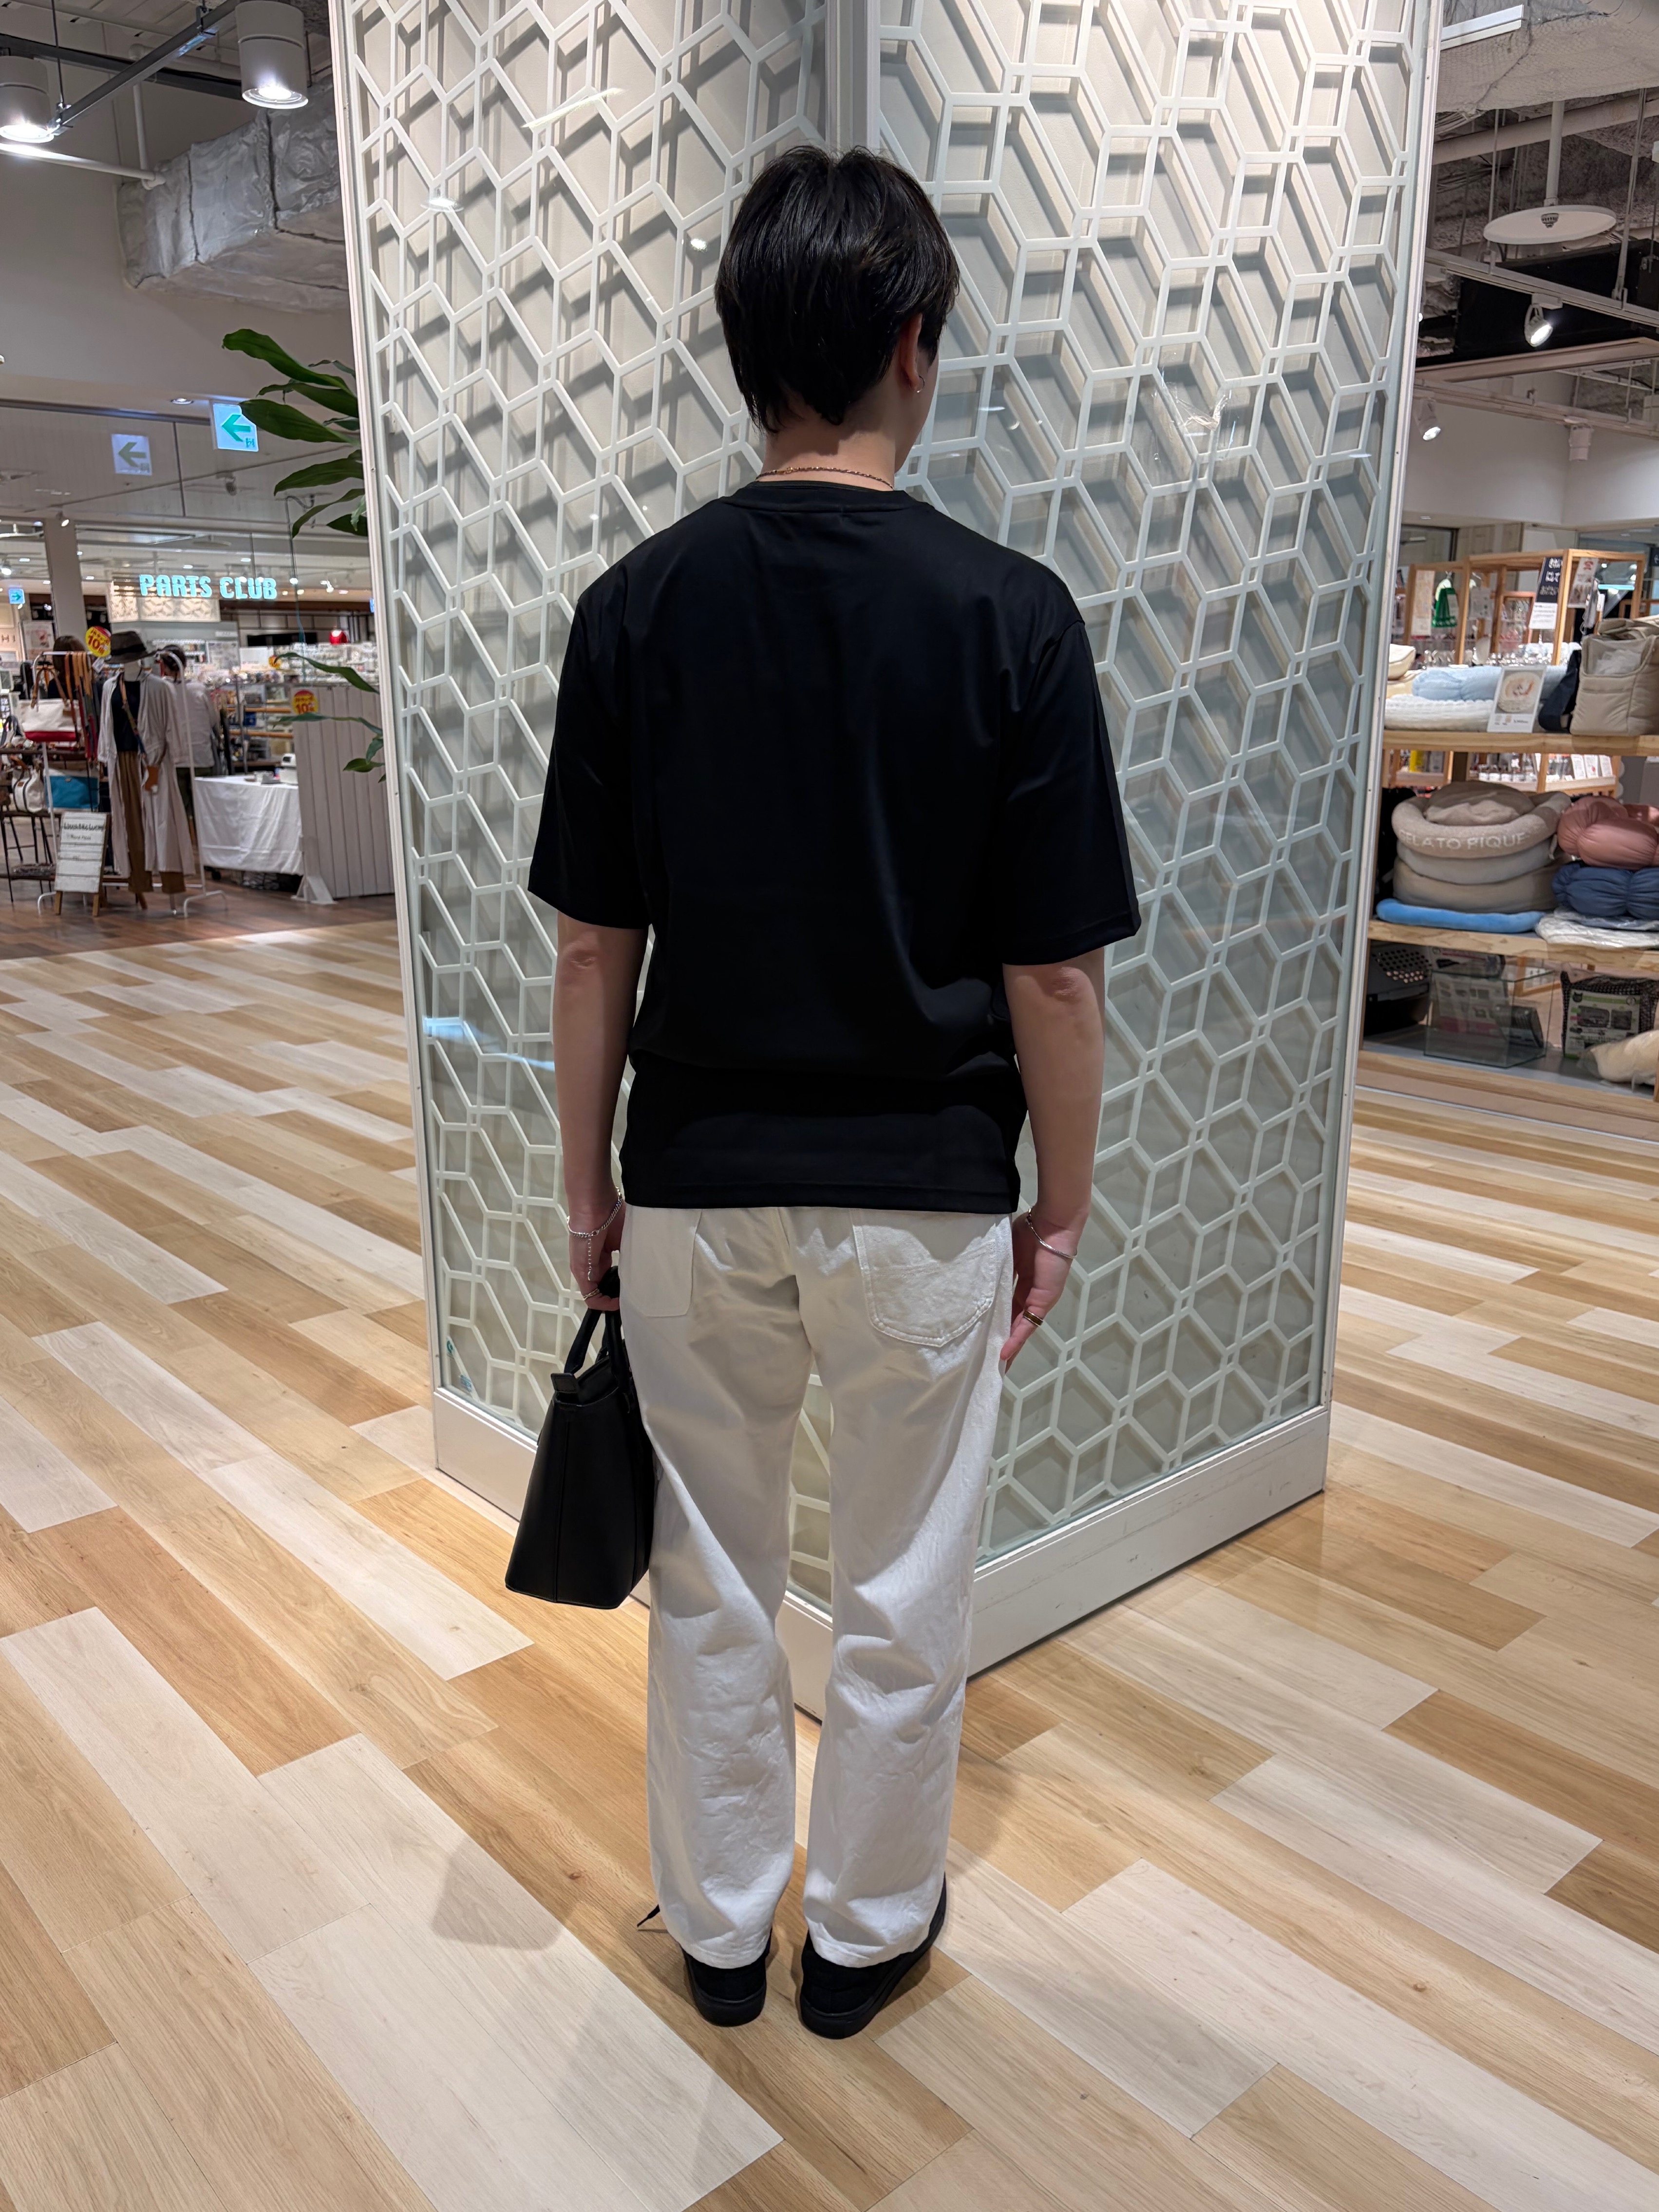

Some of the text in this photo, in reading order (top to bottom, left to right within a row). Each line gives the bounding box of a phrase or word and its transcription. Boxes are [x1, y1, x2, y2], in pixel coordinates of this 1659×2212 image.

[138, 574, 277, 599] PARTS CLUB
[1467, 832, 1528, 850] PIQUE
